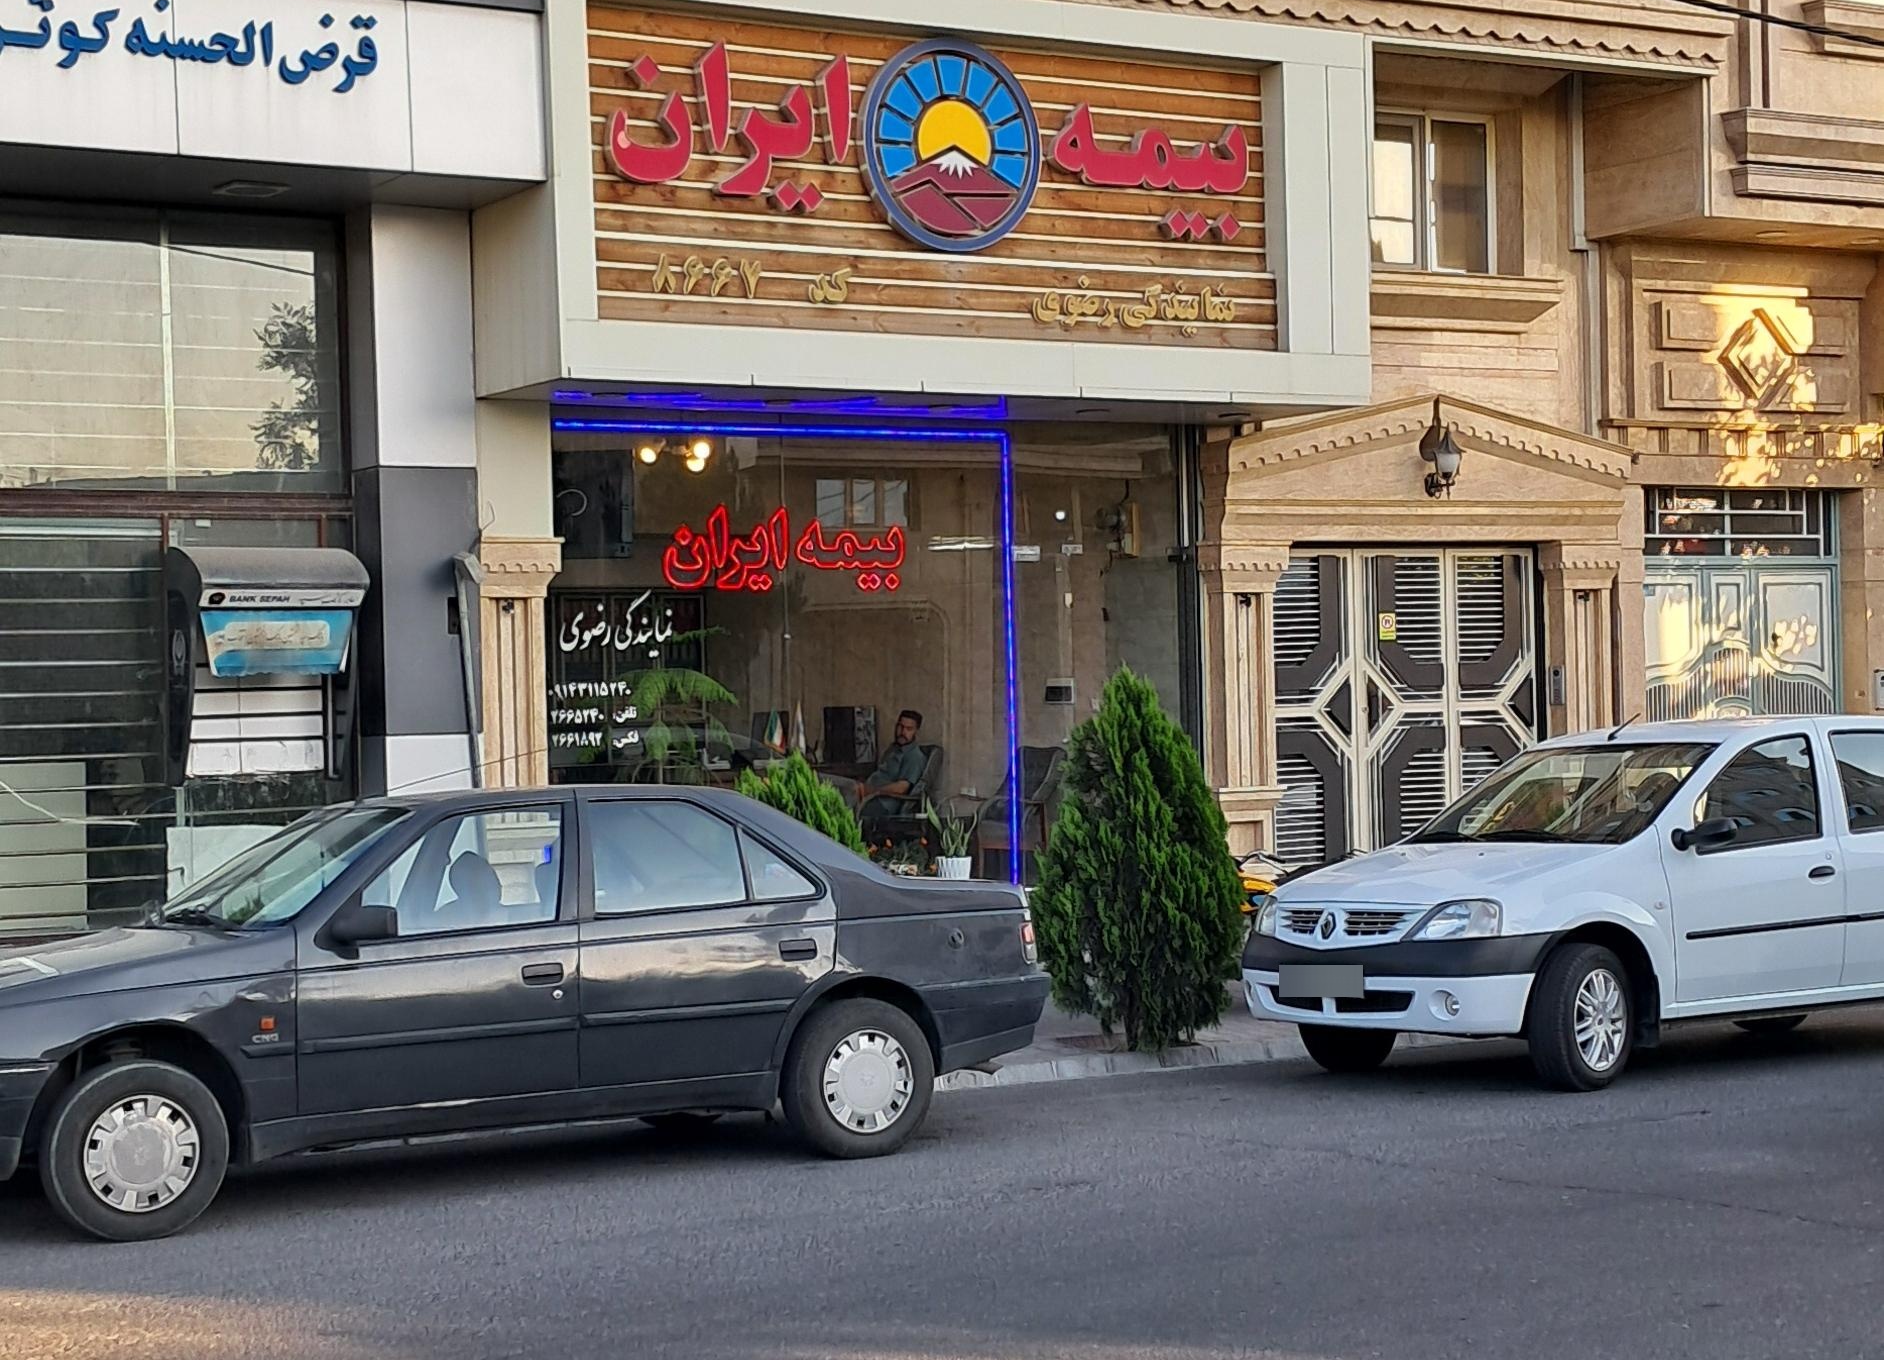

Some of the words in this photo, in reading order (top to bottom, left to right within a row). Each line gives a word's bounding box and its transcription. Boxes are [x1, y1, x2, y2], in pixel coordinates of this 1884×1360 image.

[279, 13, 378, 94] قرض
[603, 40, 852, 215] ایران
[1046, 102, 1250, 242] بیمه
[652, 252, 762, 299] ۸۶۶۷
[808, 267, 852, 304] کد
[1032, 274, 1115, 328] رضوی
[1119, 280, 1235, 338] نمایندگی
[662, 502, 789, 592] ایران
[796, 517, 907, 592] بیمه
[229, 594, 257, 603] BANK
[259, 594, 291, 603] SEPAH
[559, 603, 611, 652] رضوی
[614, 589, 673, 658] نمایندگی
[251, 1033, 280, 1044] CNG
